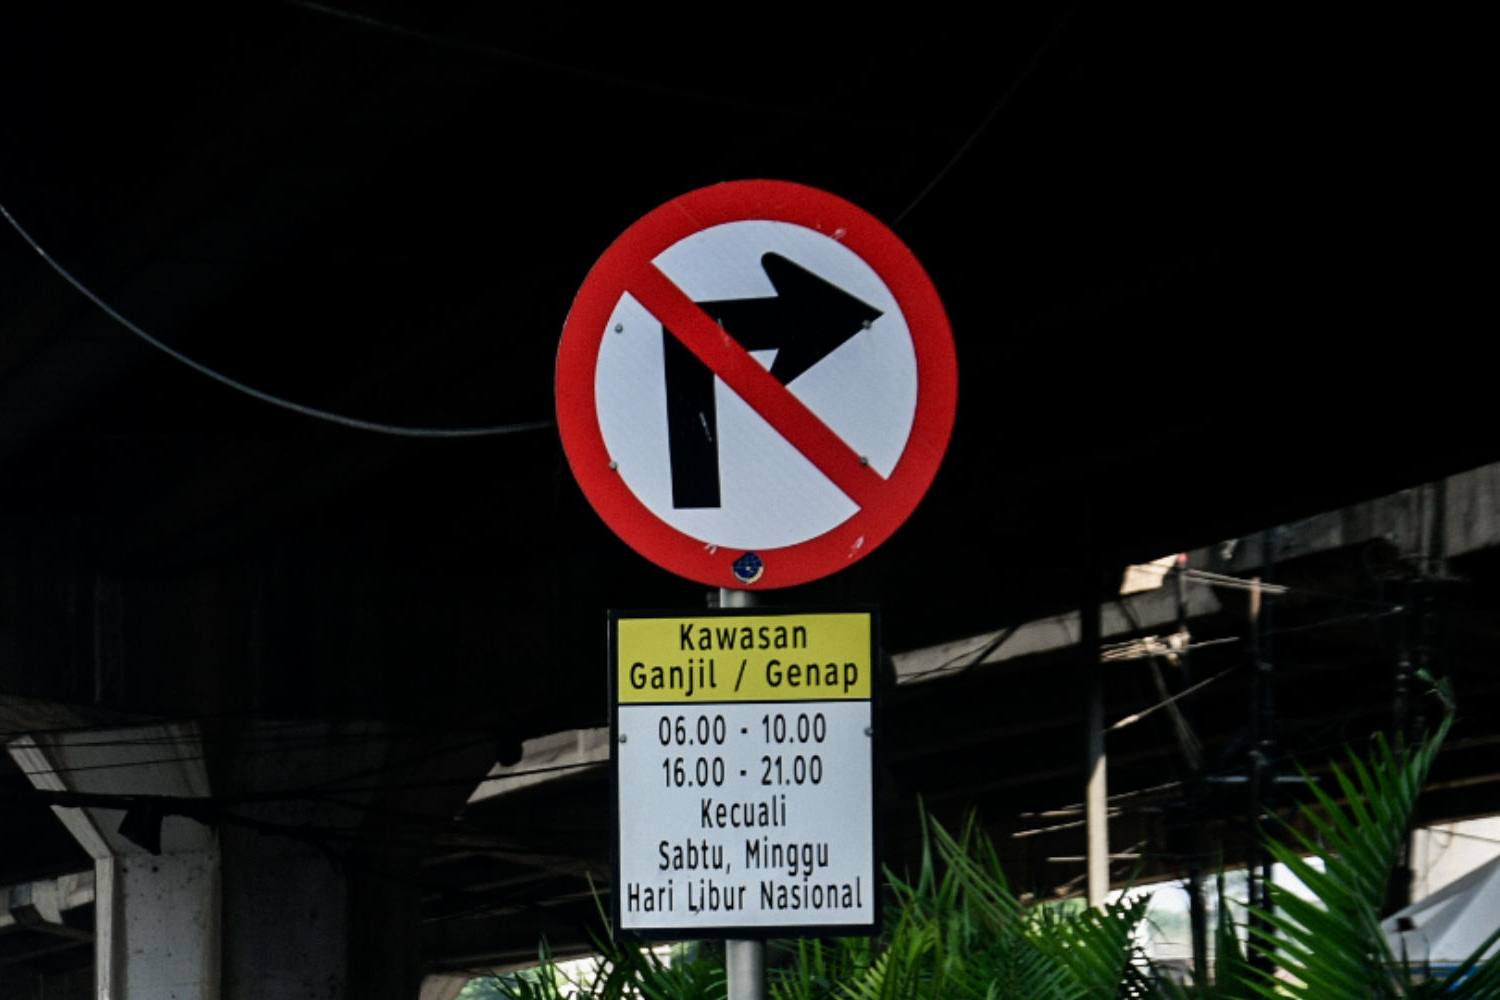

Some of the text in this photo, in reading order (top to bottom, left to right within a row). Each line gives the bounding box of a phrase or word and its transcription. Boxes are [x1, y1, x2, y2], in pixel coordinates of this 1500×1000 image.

[680, 623, 807, 651] Kawasan
[630, 659, 859, 697] Ganjil / Genap
[658, 714, 726, 745] 06.00
[761, 713, 827, 744] 10.00
[662, 756, 725, 787] 16.00
[760, 755, 823, 786] 21.00
[700, 794, 787, 828] Kecuali
[658, 836, 829, 877] Sabtu, Minggu
[627, 876, 863, 912] Hari Libur Nasional
